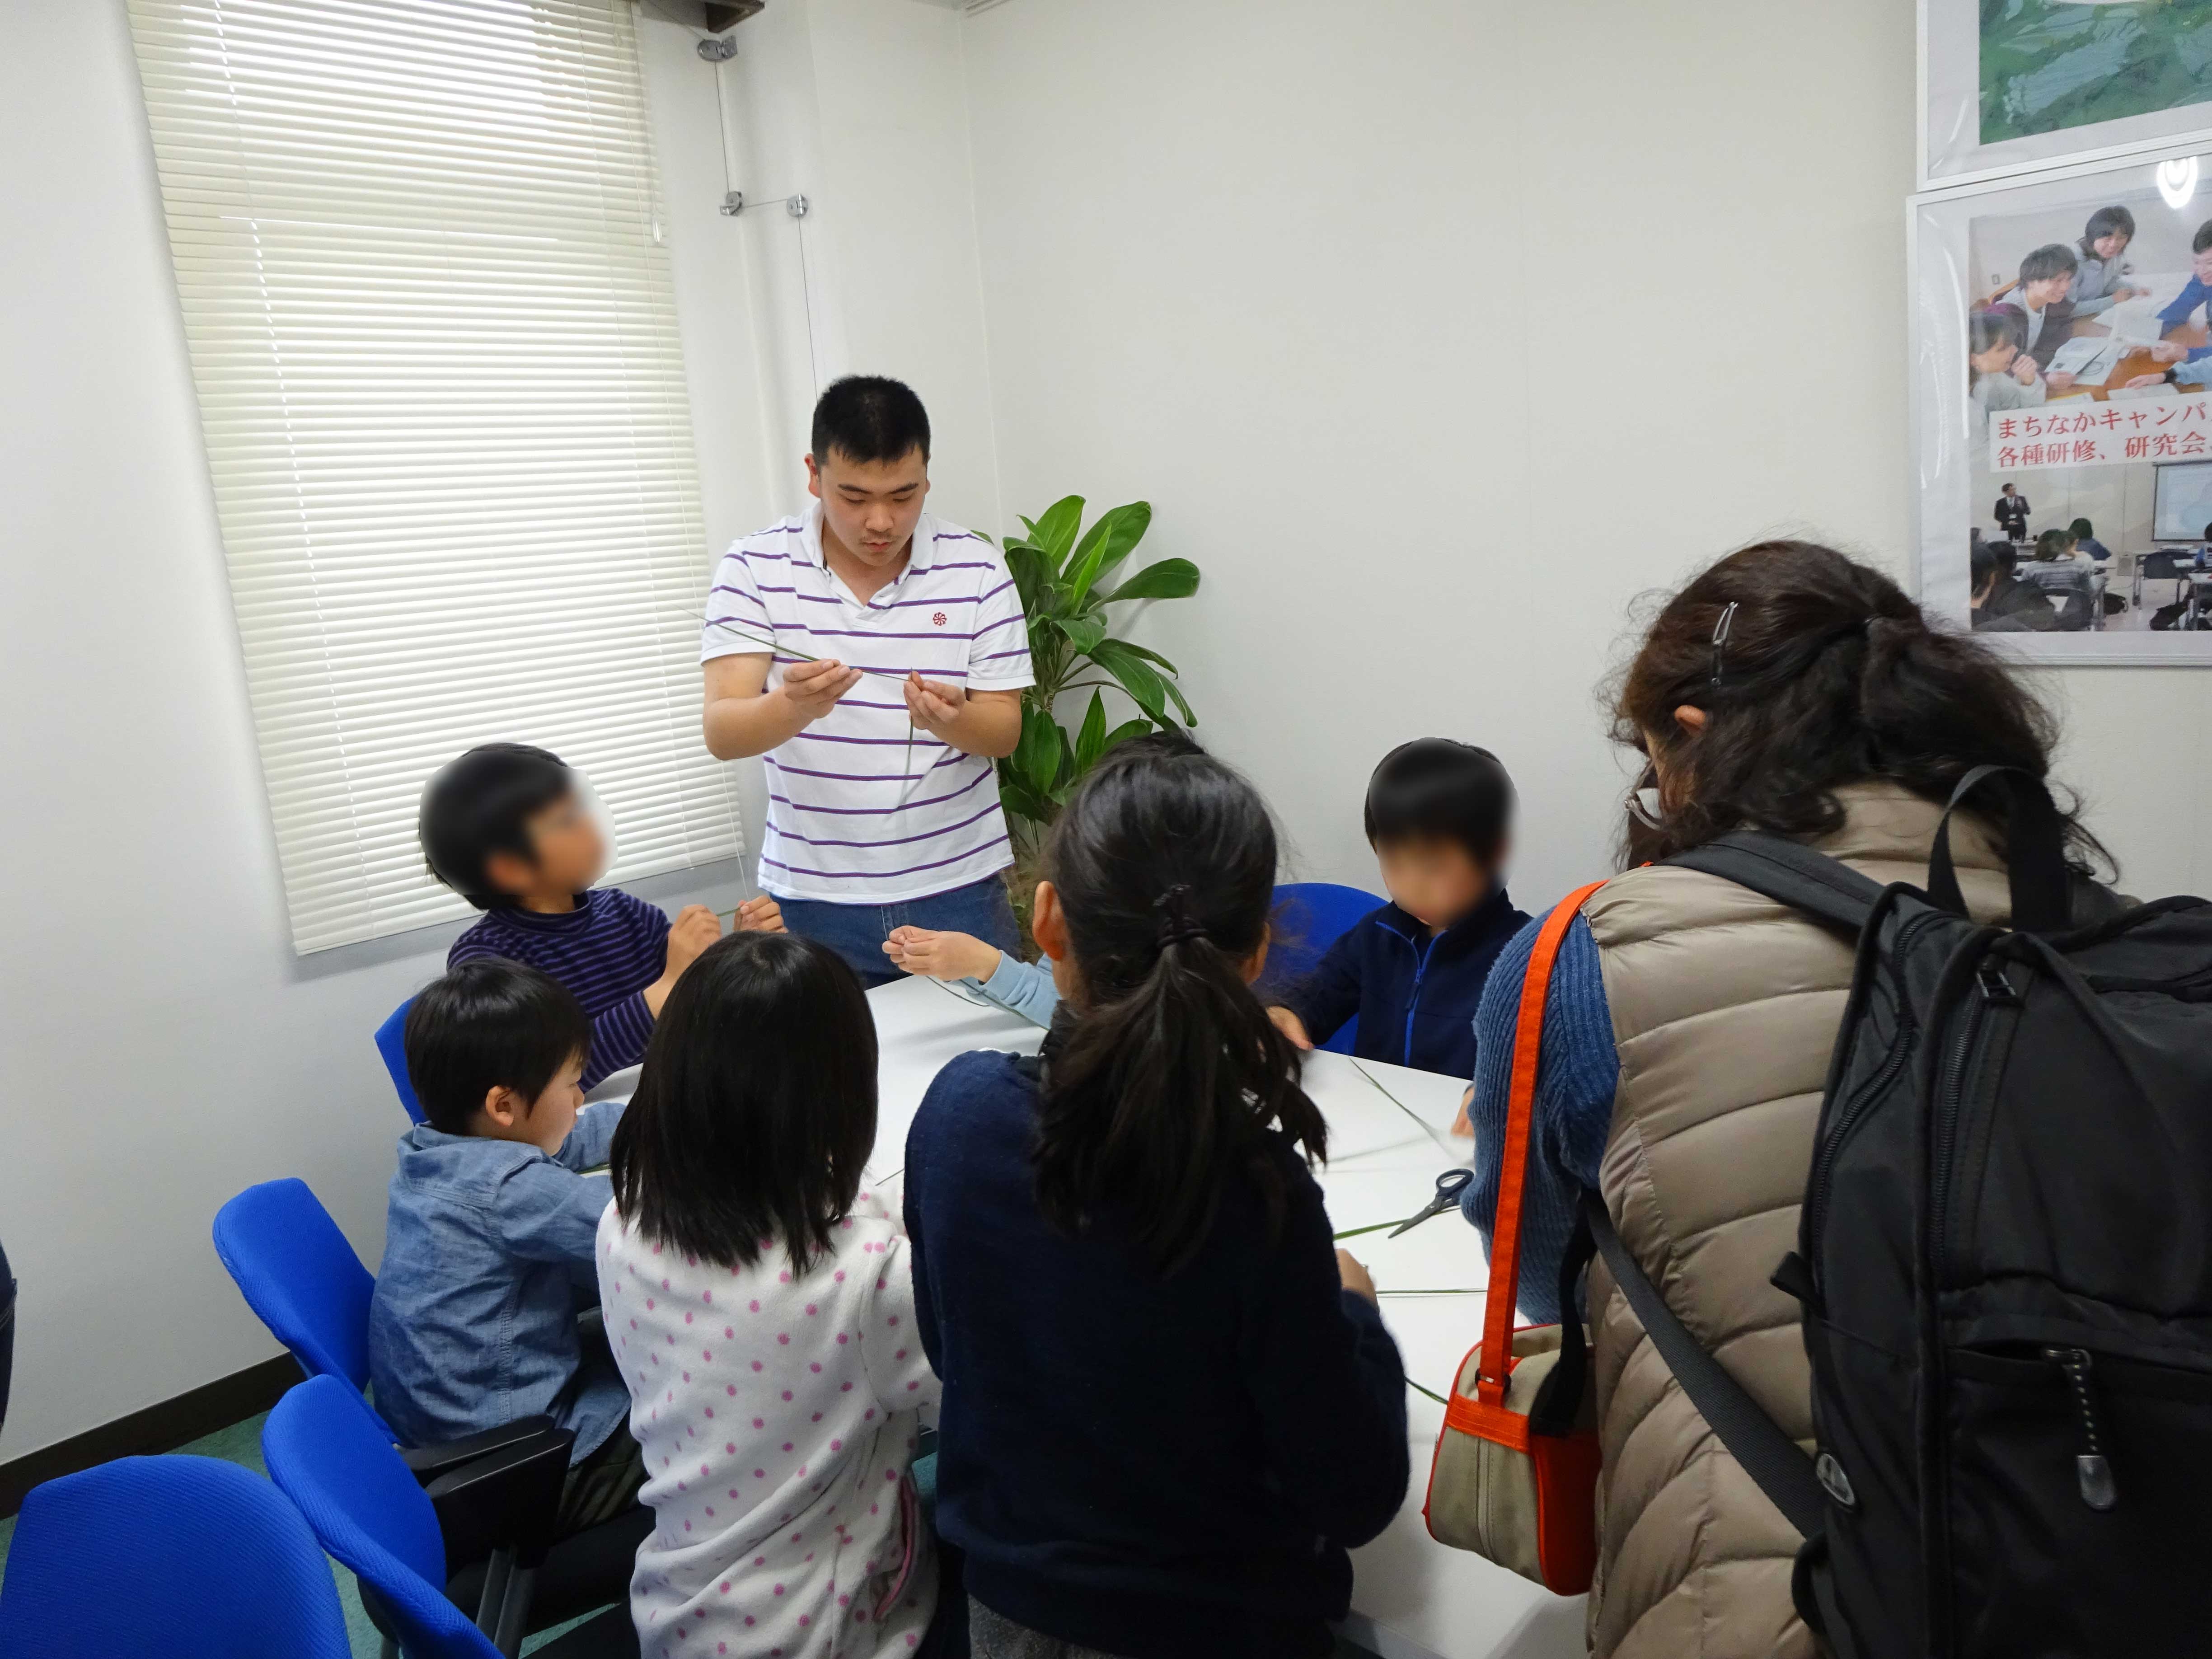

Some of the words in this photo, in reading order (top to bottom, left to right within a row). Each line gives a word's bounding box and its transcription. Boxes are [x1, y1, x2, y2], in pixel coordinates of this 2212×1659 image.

[1998, 402, 2212, 439] まちなかキャンパ
[1997, 431, 2212, 468] 各種研修、研究会
